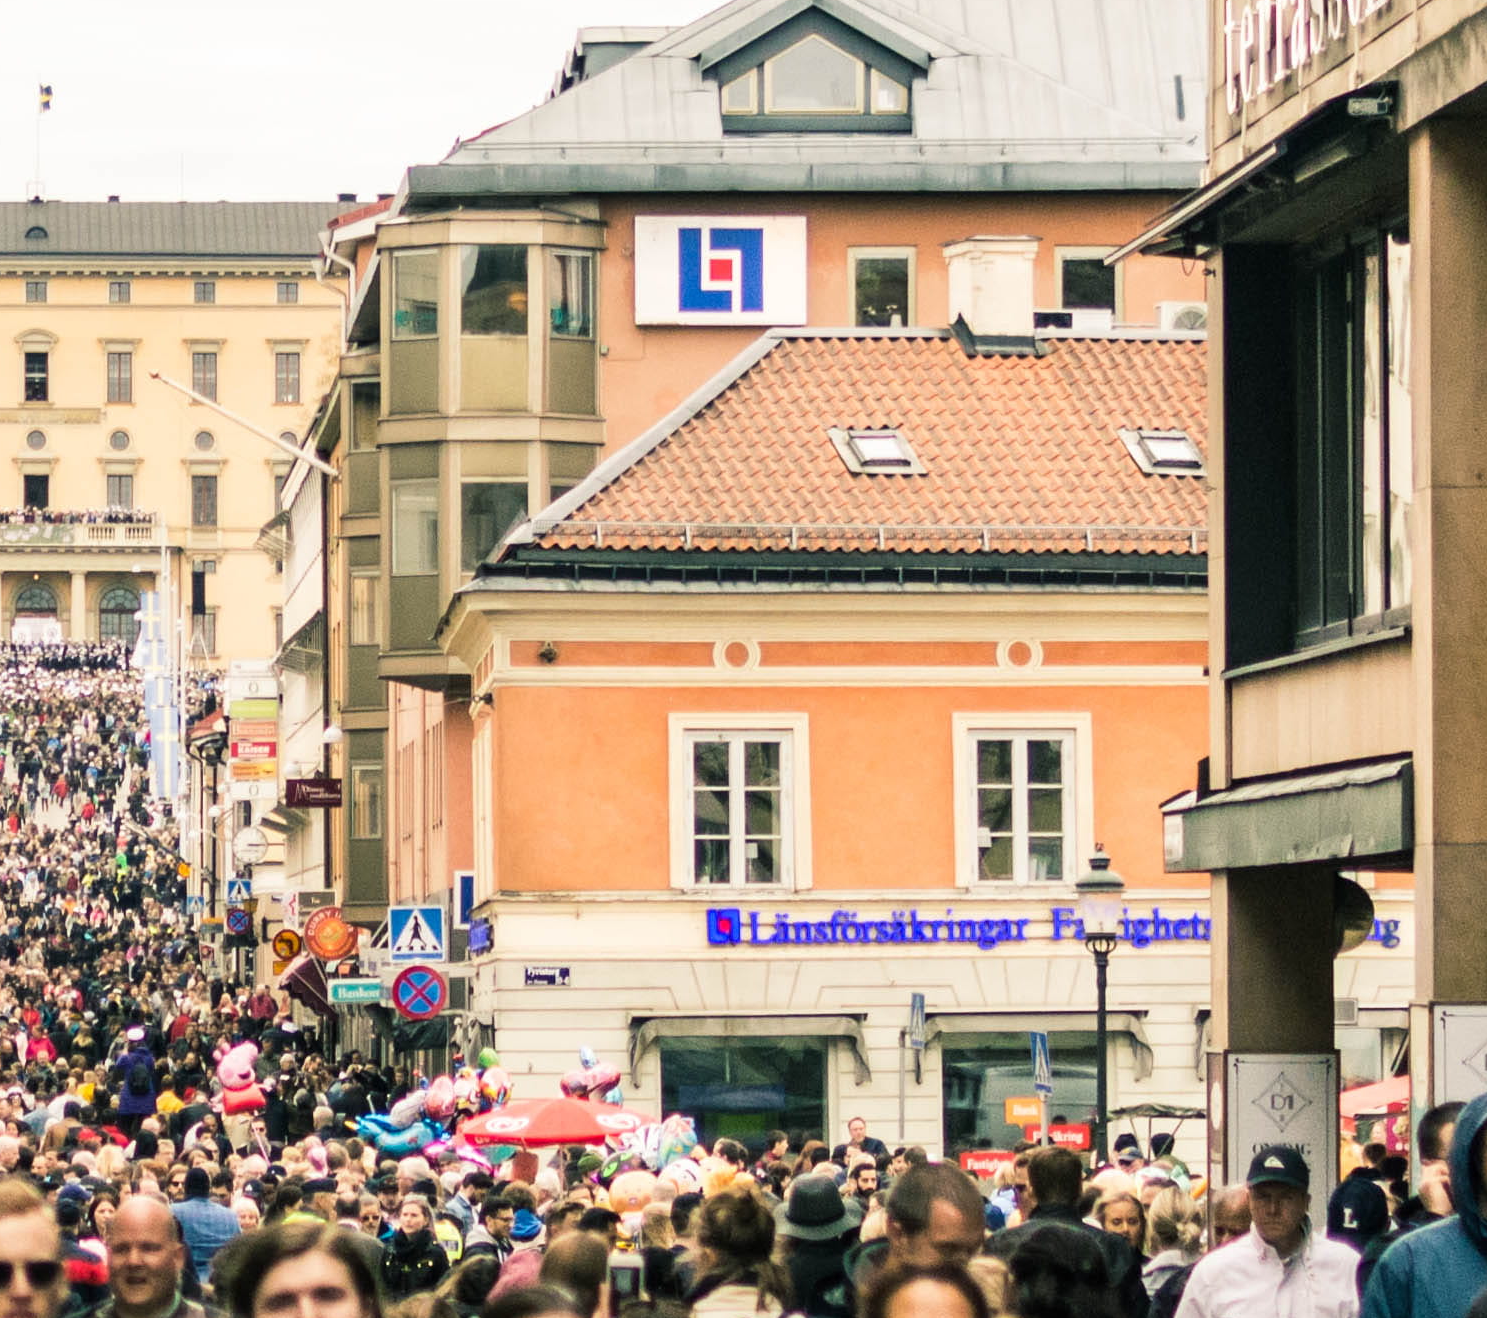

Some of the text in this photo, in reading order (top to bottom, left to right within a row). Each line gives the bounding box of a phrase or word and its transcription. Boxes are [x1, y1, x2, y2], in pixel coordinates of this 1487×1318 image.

[747, 906, 1211, 949] Länsförsäkringar Faighets
[1343, 1207, 1358, 1229] L
